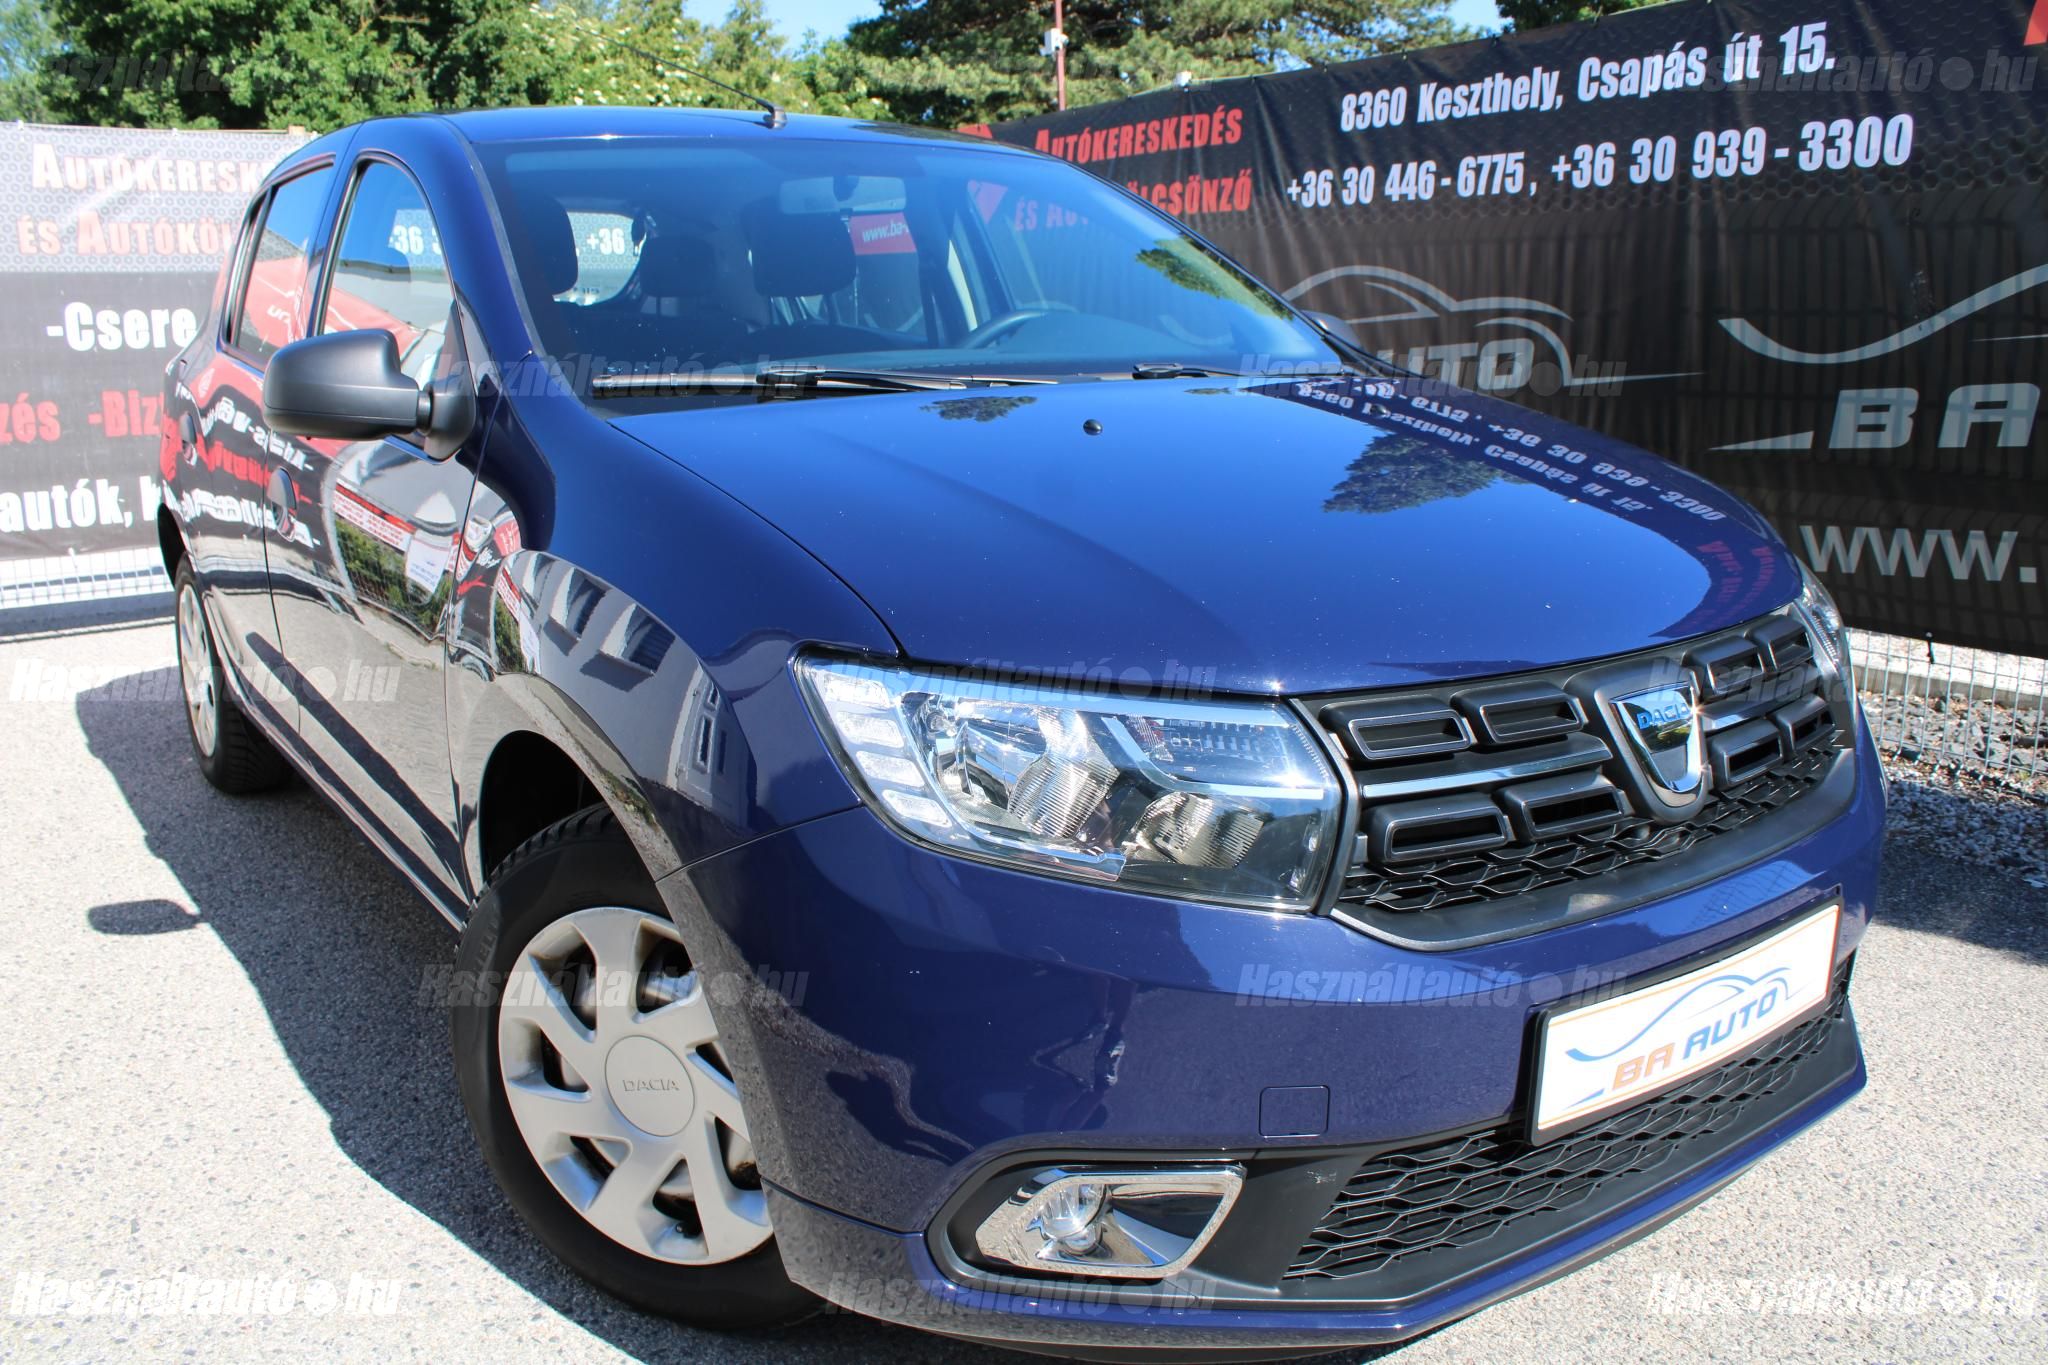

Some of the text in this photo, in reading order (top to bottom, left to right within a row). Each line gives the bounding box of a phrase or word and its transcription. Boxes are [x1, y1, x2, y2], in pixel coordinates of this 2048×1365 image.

[1340, 22, 1835, 132] 8360 Keszthely, Csapás út 15.
[1035, 105, 1243, 164] AUTÓKERESKEDÉS
[1287, 169, 1333, 208] +36
[1342, 165, 1375, 205] 30
[1552, 142, 1616, 189] +36
[1629, 136, 1677, 184] 30
[46, 302, 198, 351] -Csere
[1799, 525, 2037, 583] www.
[1612, 986, 1780, 1091] BA AUTO
[622, 1078, 680, 1092] DACIA
